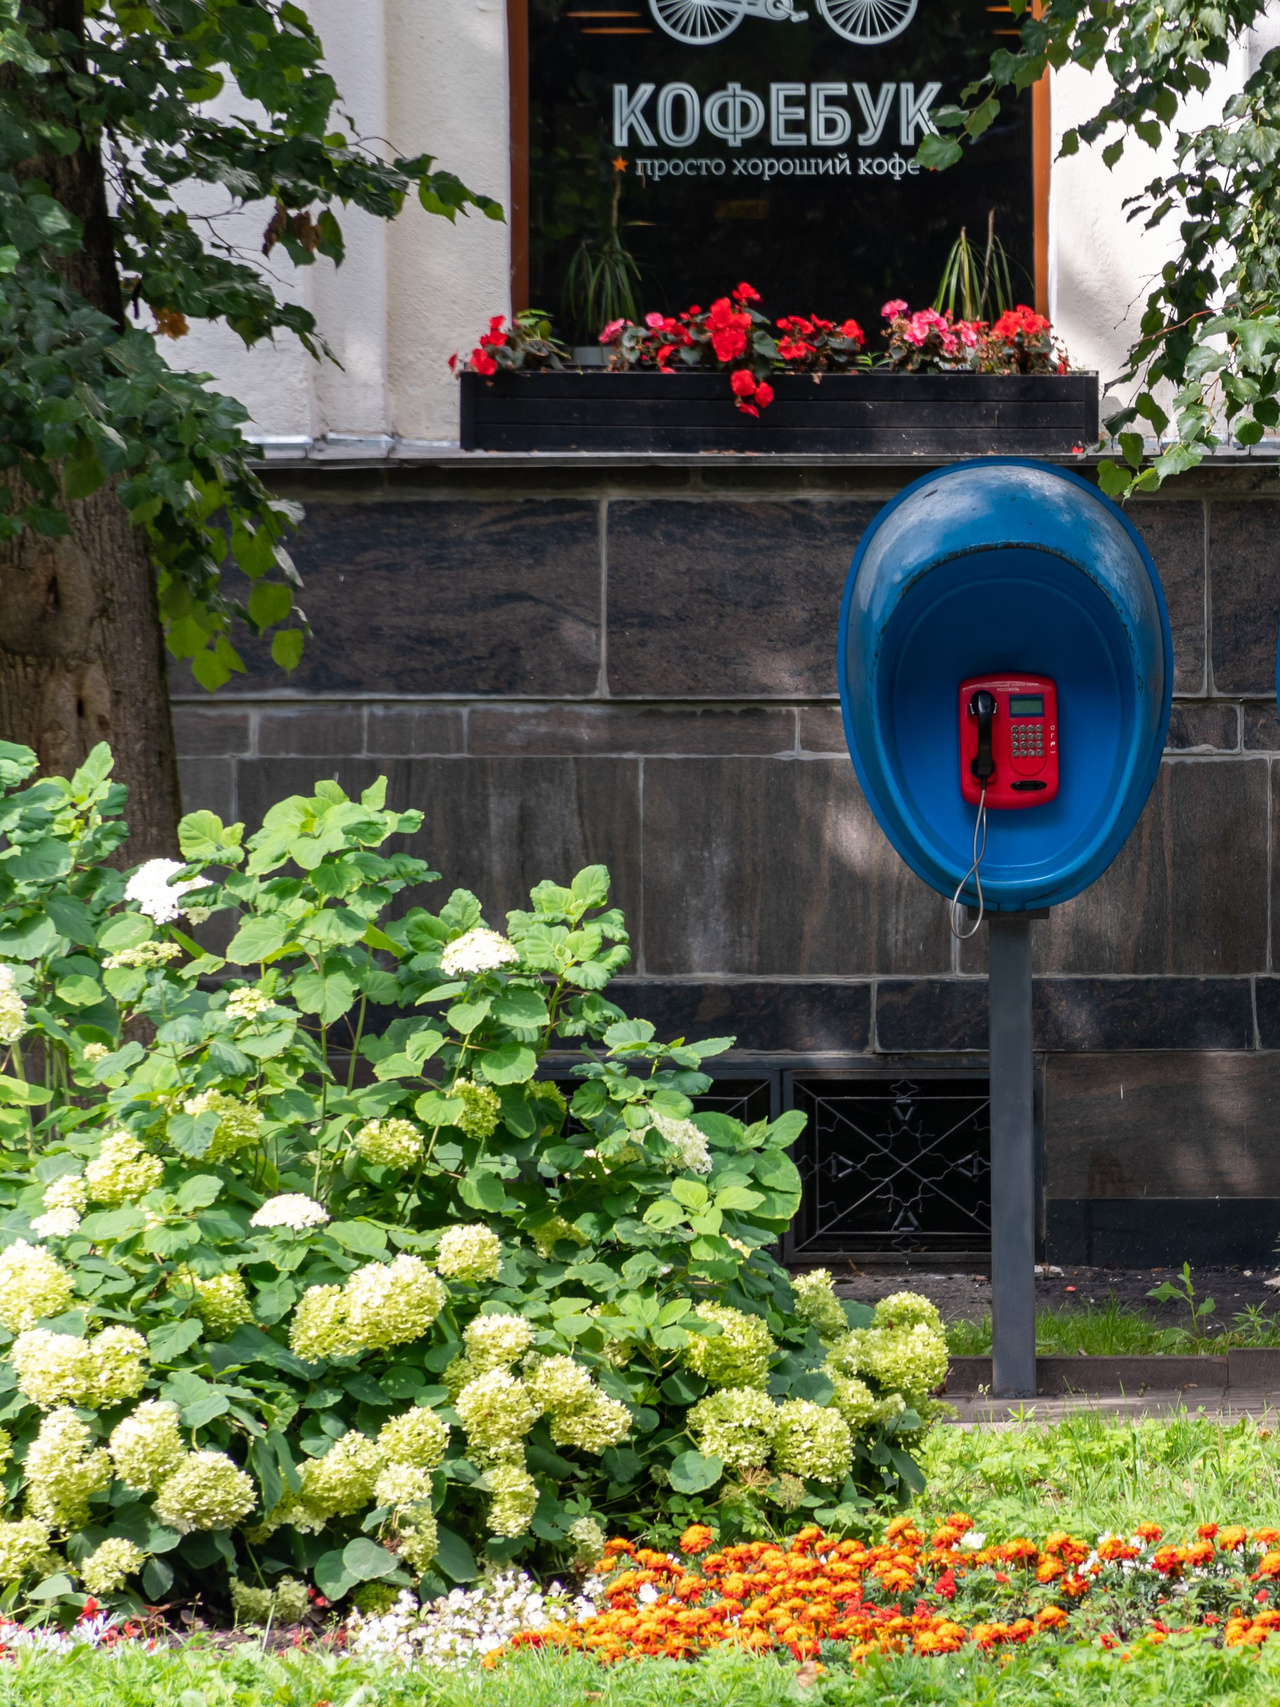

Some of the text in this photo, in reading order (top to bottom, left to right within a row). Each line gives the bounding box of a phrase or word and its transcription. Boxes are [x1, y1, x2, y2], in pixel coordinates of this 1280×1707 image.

[612, 82, 943, 147] КОФЕБУК
[635, 152, 921, 180] просто хороший кофе
